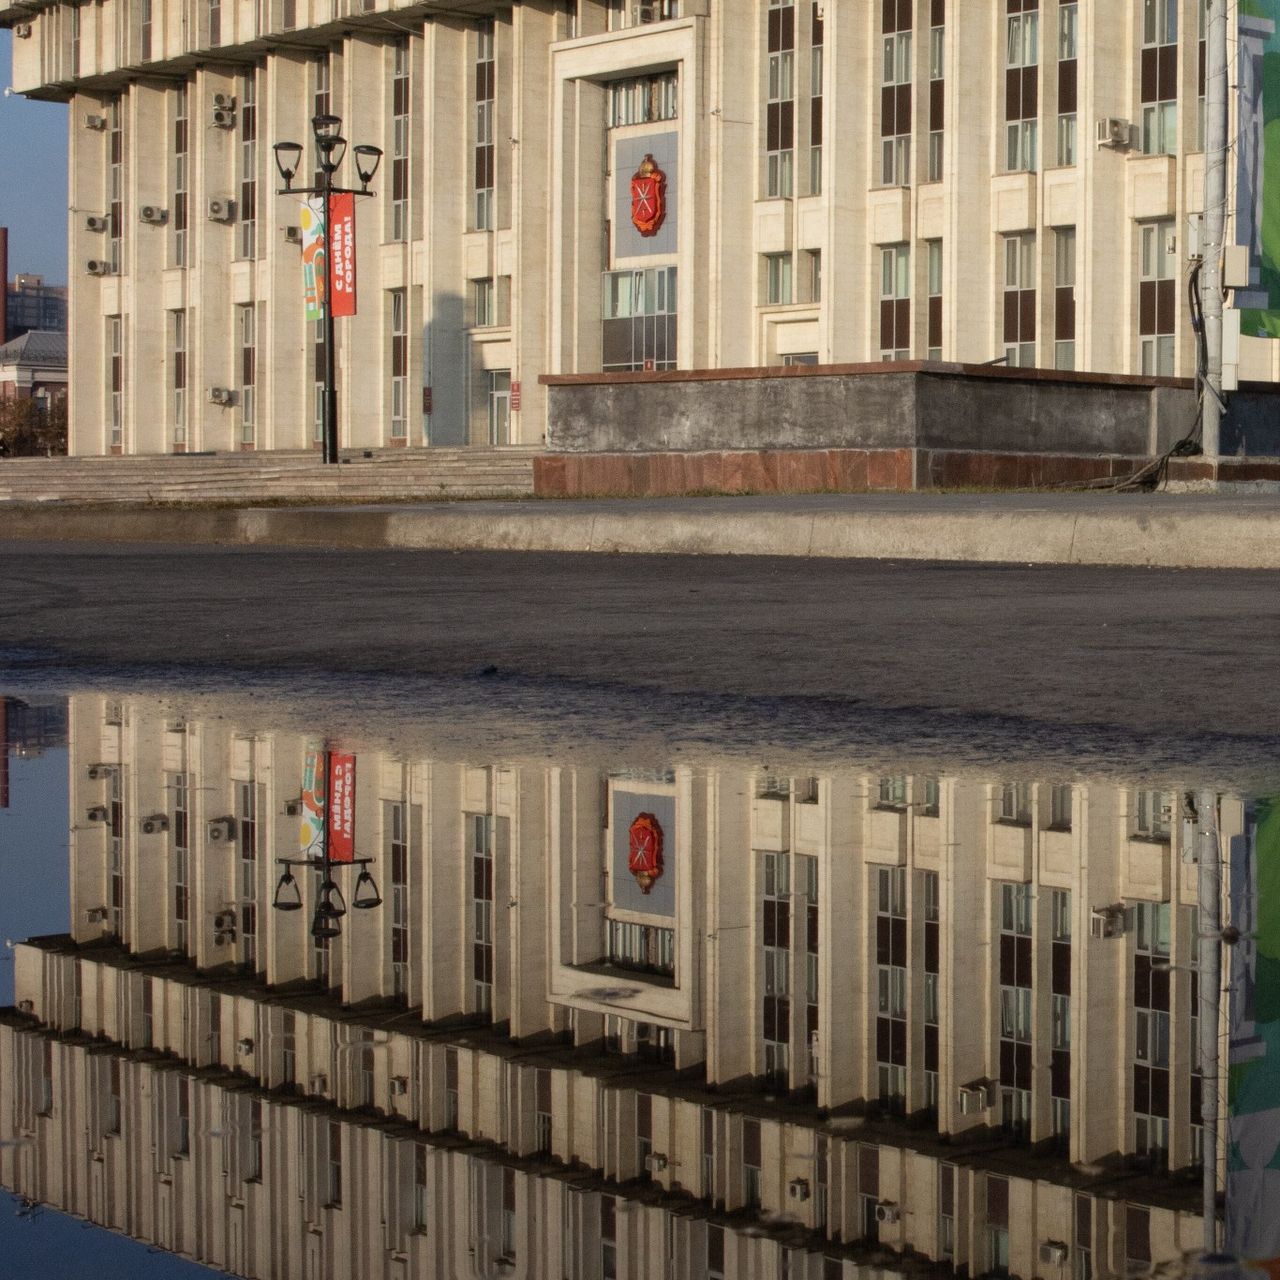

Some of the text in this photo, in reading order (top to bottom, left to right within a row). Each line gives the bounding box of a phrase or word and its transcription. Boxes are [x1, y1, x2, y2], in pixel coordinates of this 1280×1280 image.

[333, 224, 343, 291] С ДНЁМ
[344, 216, 352, 293] ГОРОДА!
